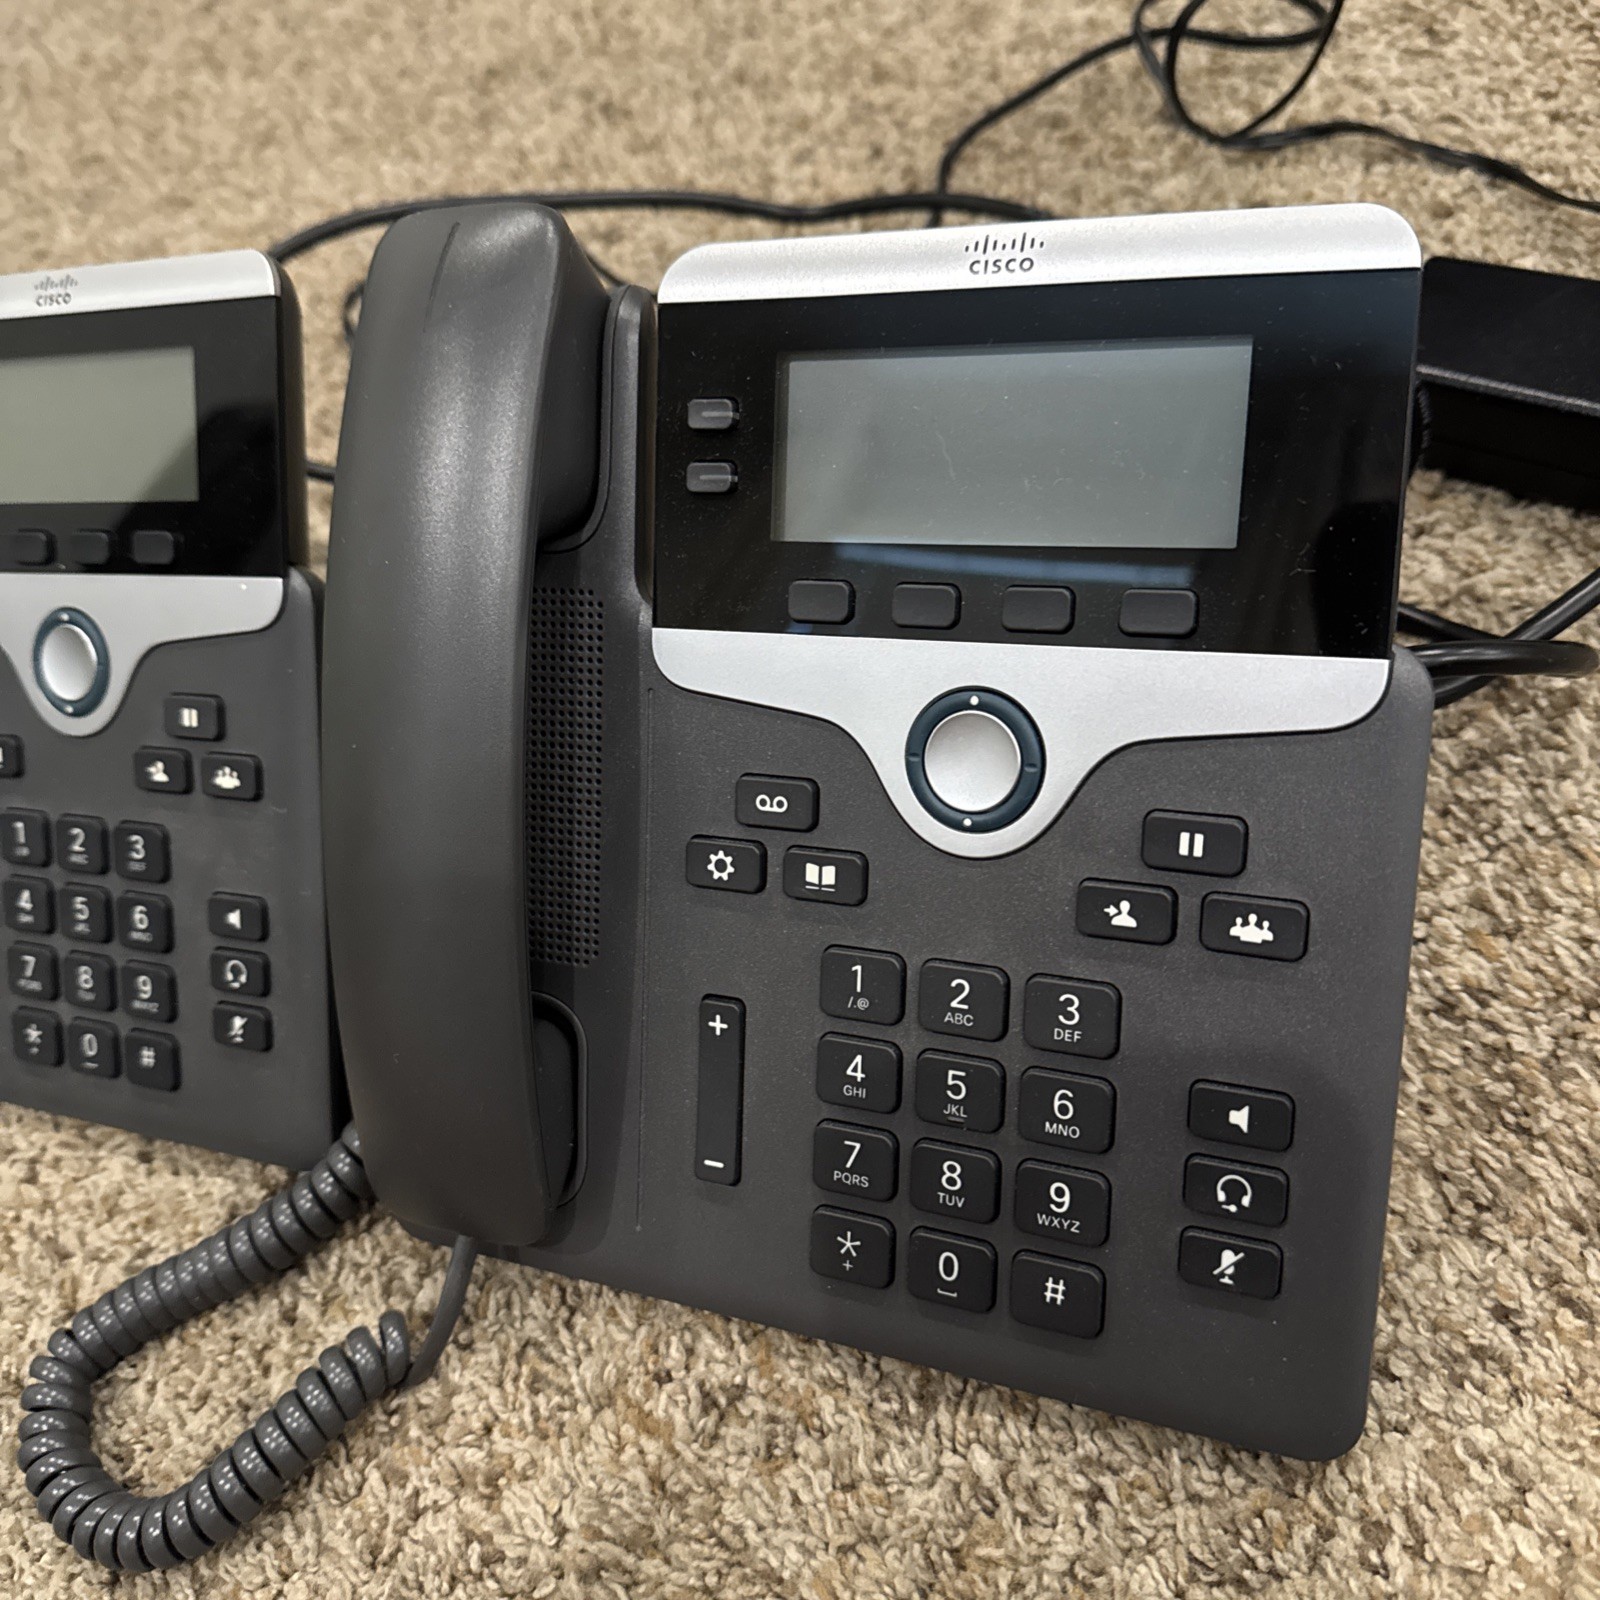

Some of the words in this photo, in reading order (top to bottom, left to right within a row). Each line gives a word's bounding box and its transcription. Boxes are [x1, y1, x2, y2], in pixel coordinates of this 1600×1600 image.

[969, 251, 1035, 275] CISCO
[11, 821, 26, 843] 1
[68, 827, 86, 852] 2
[127, 834, 146, 860] 3
[15, 889, 33, 911] 4
[72, 896, 90, 921] 5
[131, 905, 149, 930] 6
[20, 955, 36, 977] 7
[76, 965, 93, 989] 8
[135, 975, 152, 999] 9
[851, 964, 862, 993] 1
[949, 978, 970, 1010] 2
[943, 1011, 974, 1027] ABC
[1057, 993, 1080, 1026] 3
[80, 1033, 98, 1057] 0
[1053, 1027, 1082, 1043] DEF
[845, 1054, 866, 1083] 4
[842, 1084, 867, 1099] GHI
[946, 1069, 967, 1101] 5
[943, 1103, 968, 1118] JKL
[1053, 1089, 1074, 1120] 6
[1044, 1121, 1080, 1139] MNO
[843, 1140, 861, 1169] 7
[833, 1170, 869, 1188] PQRS
[941, 1160, 962, 1191] 8
[937, 1191, 965, 1208] TUV
[1049, 1181, 1071, 1214] 9
[1036, 1212, 1081, 1234] WXYZ
[938, 1251, 959, 1282] 0
[1043, 1276, 1066, 1306] #
